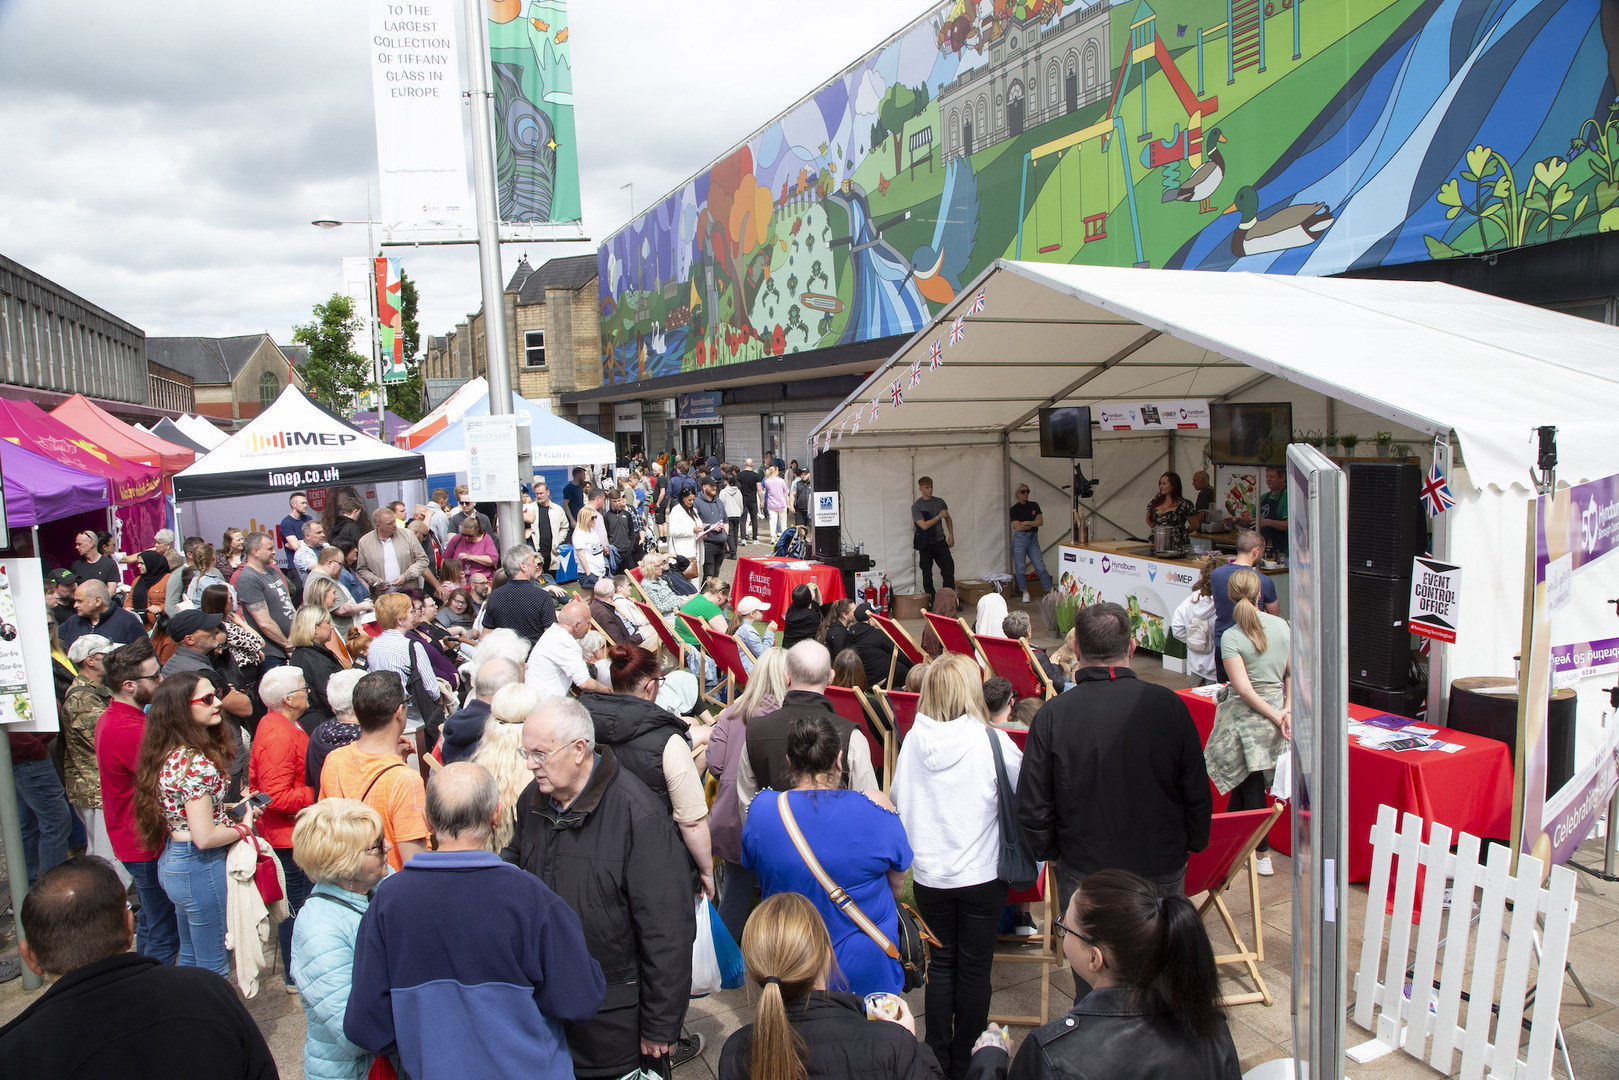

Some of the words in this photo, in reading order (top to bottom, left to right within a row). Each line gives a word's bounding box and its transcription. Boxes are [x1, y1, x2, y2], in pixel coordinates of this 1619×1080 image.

[388, 5, 403, 16] TO
[407, 4, 431, 16] THE
[384, 20, 438, 32] LARGEST
[373, 35, 451, 49] COLLECTION
[378, 53, 393, 64] OF
[397, 54, 448, 65] TIFFANY
[386, 70, 425, 81] GLASS
[429, 71, 443, 81] IN
[391, 87, 440, 98] EUROPE
[286, 431, 357, 446] iMEP
[268, 466, 340, 487] imep.co.uk
[1111, 560, 1137, 572] Hyndburn
[1147, 562, 1158, 571] Vita
[1423, 572, 1451, 589] EVENT
[1415, 583, 1456, 605] CONTROL
[1420, 598, 1450, 616] OFFICE
[1587, 647, 1619, 662] brating
[1553, 789, 1598, 849] Celebrating
